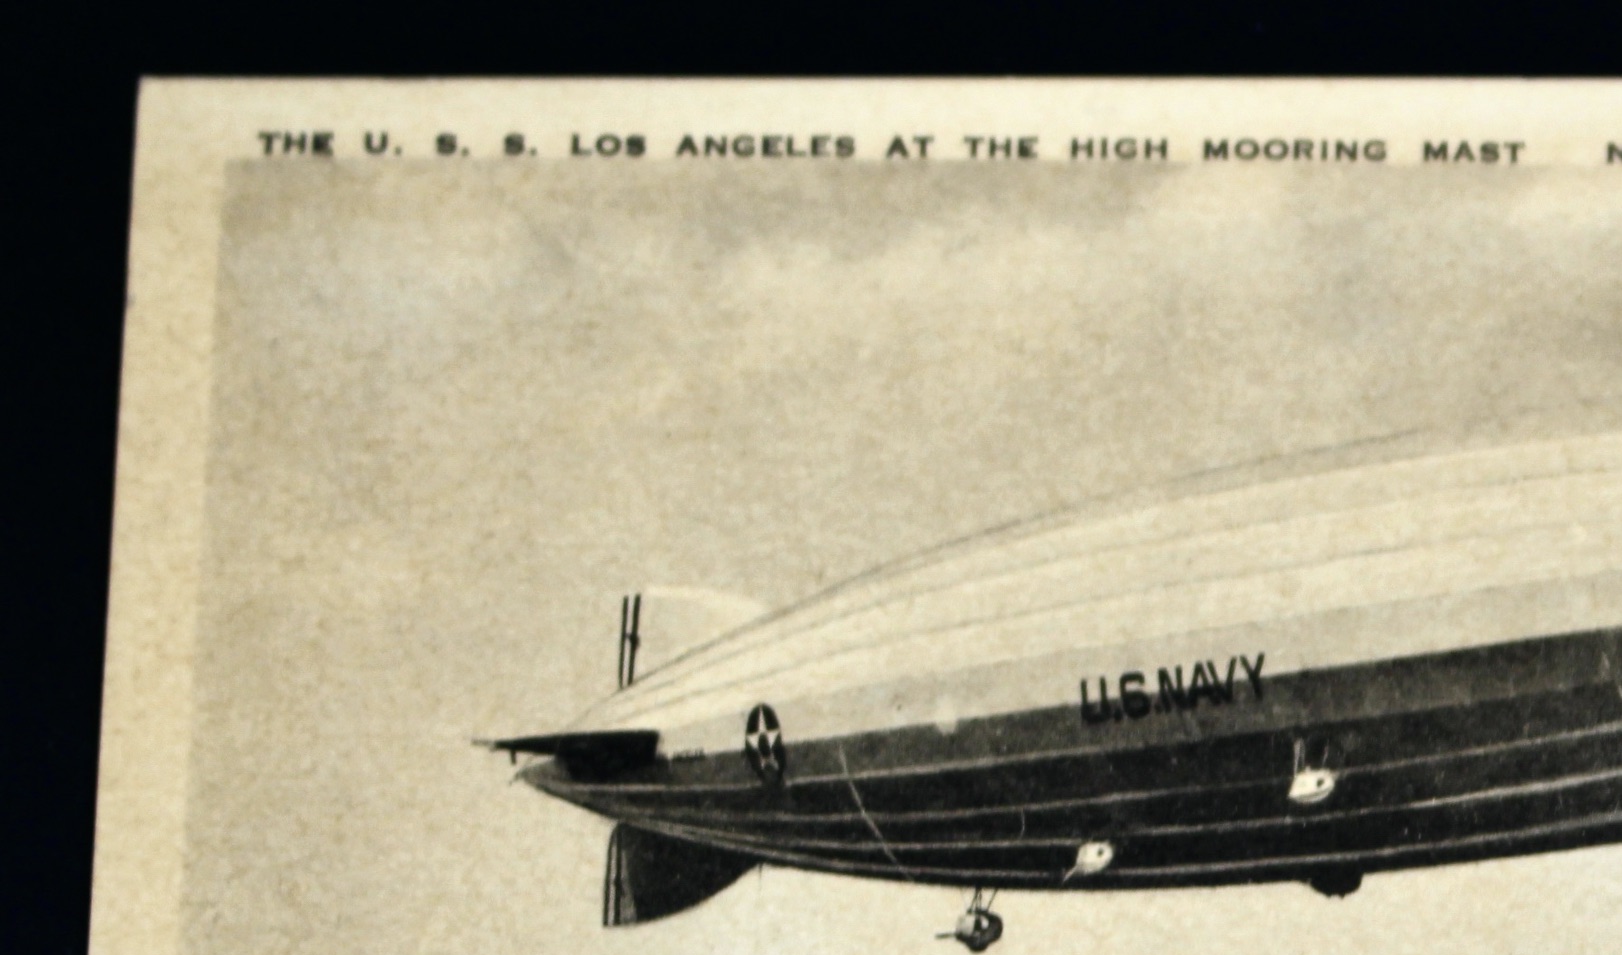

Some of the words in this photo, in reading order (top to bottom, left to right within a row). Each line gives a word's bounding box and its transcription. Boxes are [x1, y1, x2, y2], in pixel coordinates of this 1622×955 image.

[258, 131, 335, 157] THE
[363, 131, 402, 157] U.
[435, 132, 469, 157] S.
[503, 133, 537, 158] S.
[570, 133, 647, 158] LOS
[675, 134, 857, 159] ANGELES
[885, 135, 935, 159] AT
[964, 136, 1040, 160] THE
[1069, 138, 1169, 161] HIGH
[1202, 138, 1387, 163] MOORING
[1422, 140, 1526, 164] MAST
